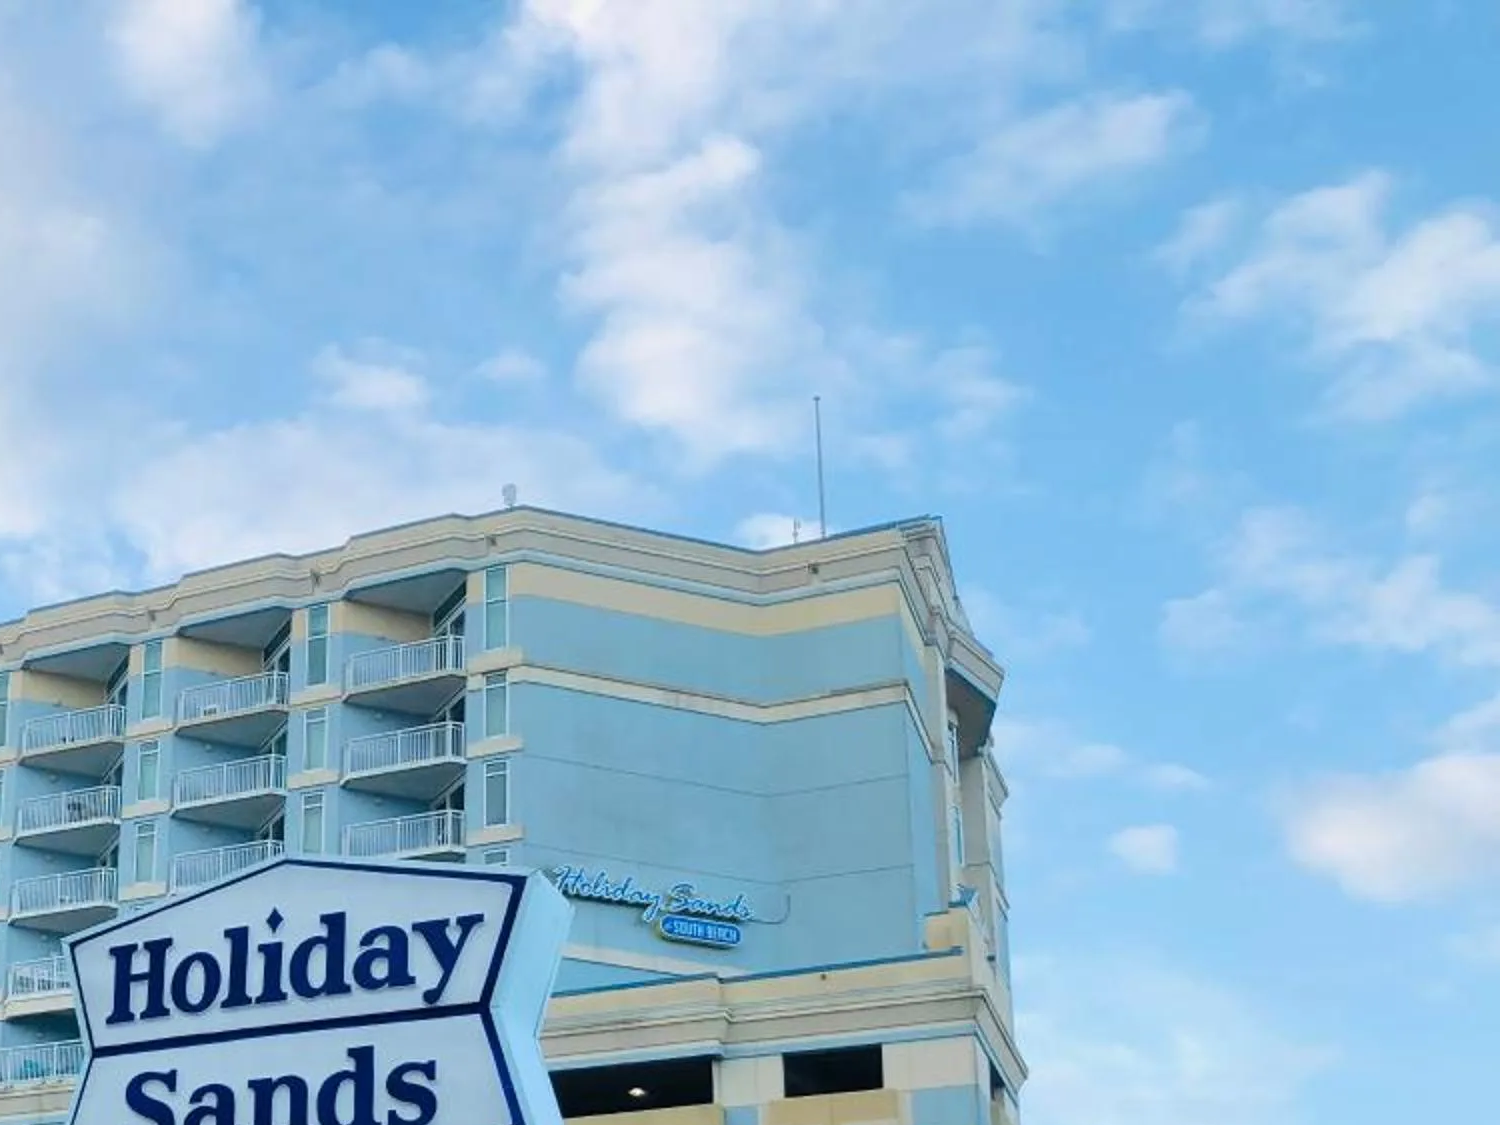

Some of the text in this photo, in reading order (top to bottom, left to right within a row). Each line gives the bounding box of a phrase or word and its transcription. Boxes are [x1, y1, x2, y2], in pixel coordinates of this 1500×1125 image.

[552, 863, 662, 923] Holiday
[673, 920, 703, 938] SOUTH
[104, 907, 485, 1025] Holiday
